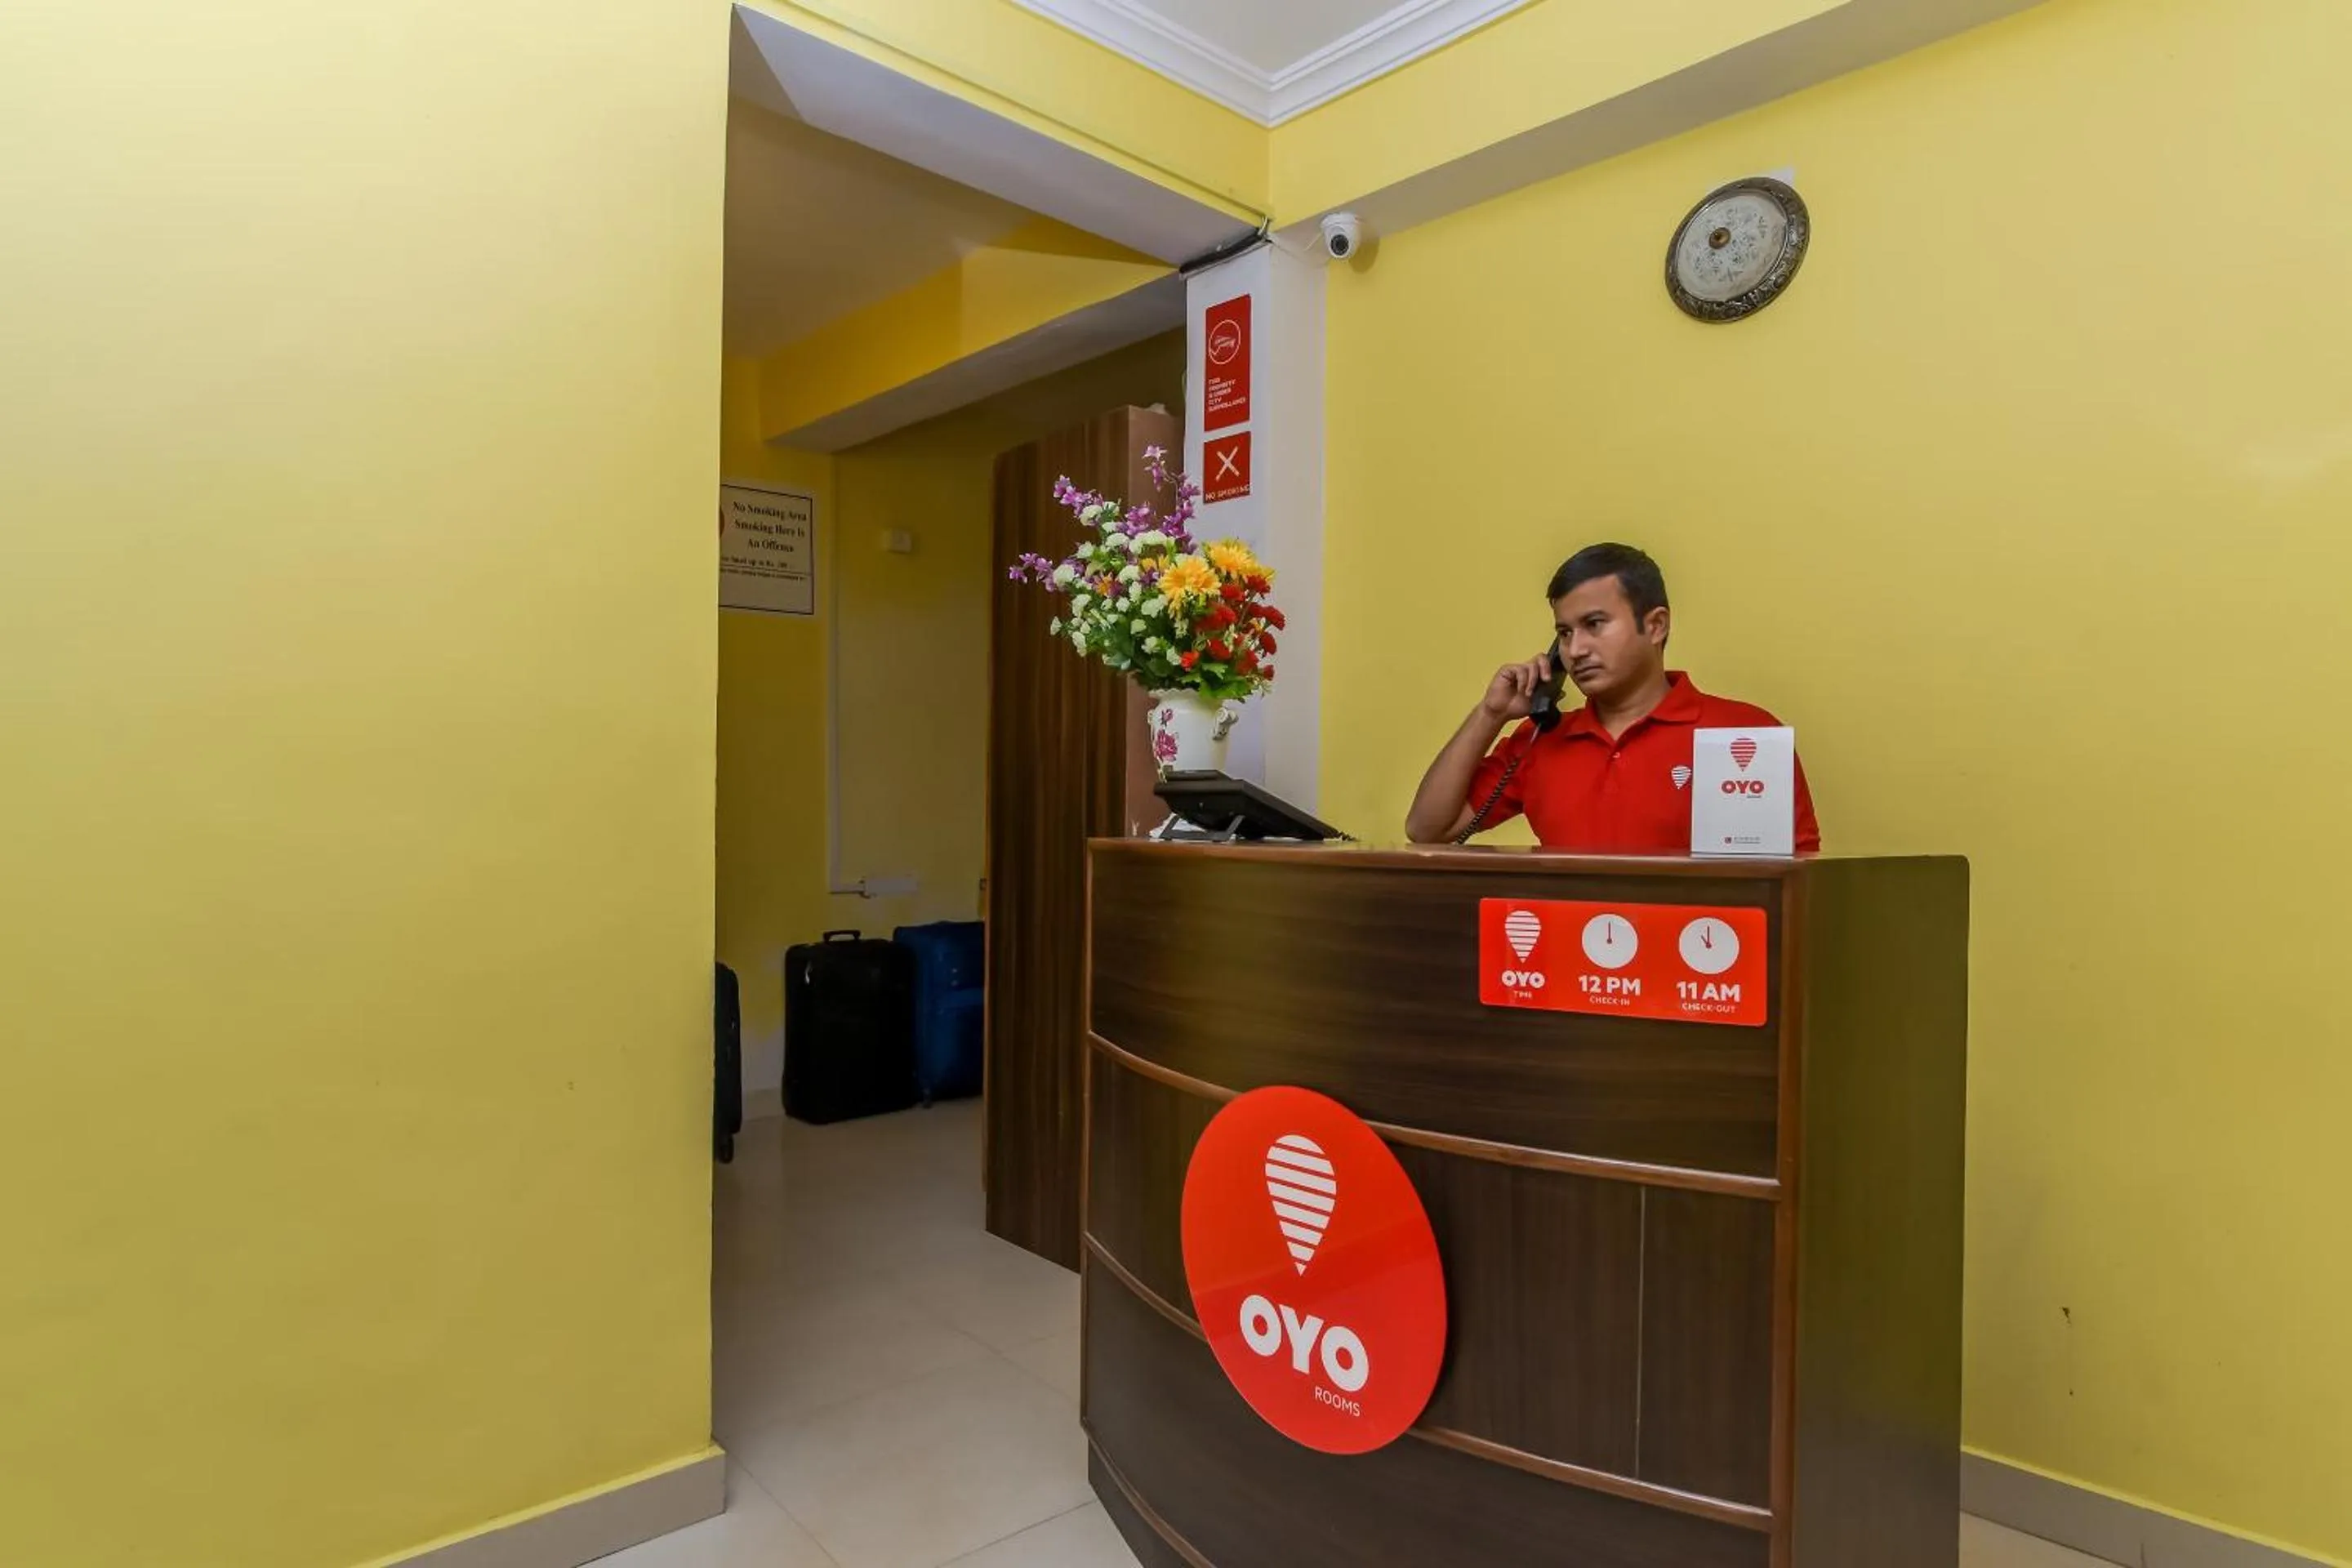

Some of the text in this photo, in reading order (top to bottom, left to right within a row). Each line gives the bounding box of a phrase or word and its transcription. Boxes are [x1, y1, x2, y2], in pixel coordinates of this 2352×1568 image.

[1205, 492, 1216, 501] NO
[733, 500, 808, 522] No Smoking Area
[735, 519, 774, 535] Smoking
[775, 523, 796, 537] Here
[747, 538, 760, 550] An
[1721, 780, 1765, 794] OYO
[1501, 969, 1545, 988] OYO
[1578, 974, 1642, 996] 12 PM
[1589, 996, 1631, 1006] CHECK-IN
[1676, 981, 1741, 1003] 11 AM
[1239, 1294, 1370, 1392] OYO
[1314, 1384, 1361, 1418] ROOMS
